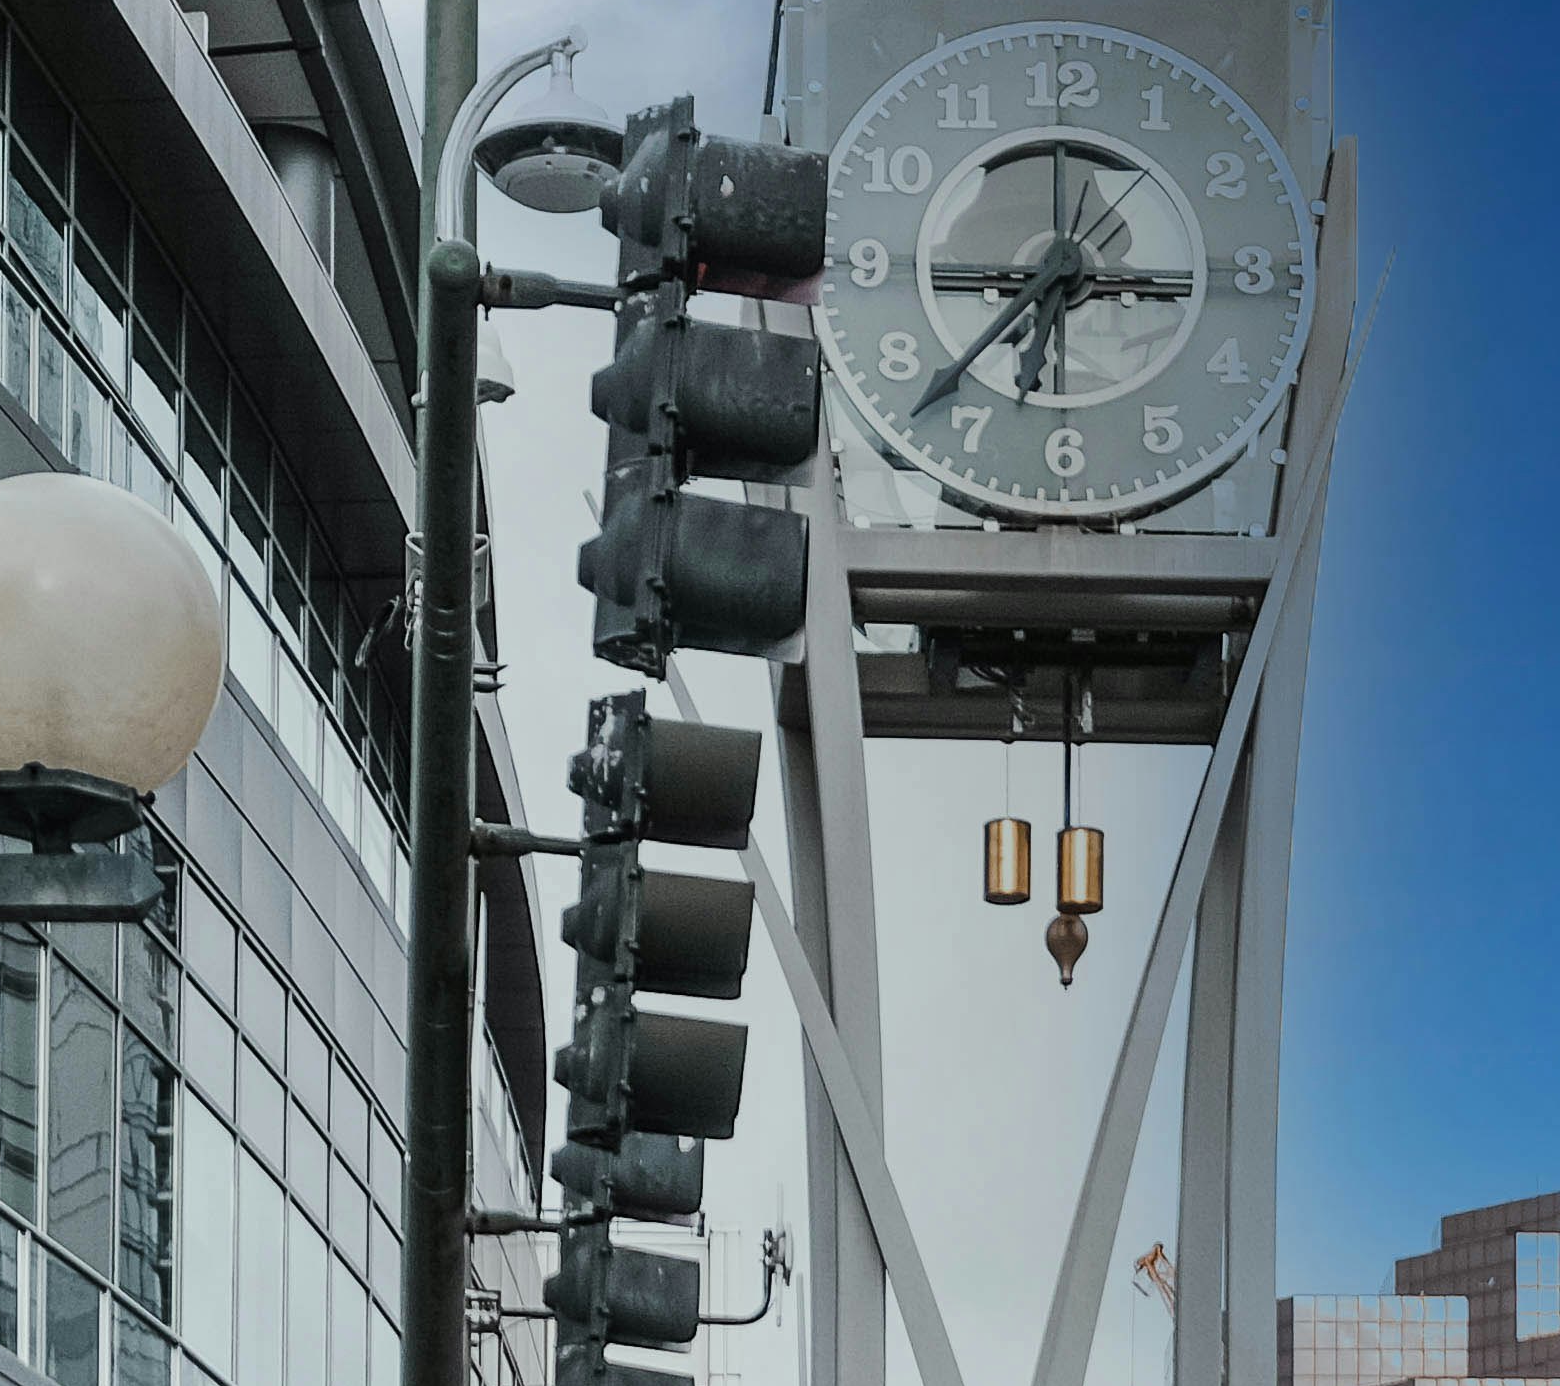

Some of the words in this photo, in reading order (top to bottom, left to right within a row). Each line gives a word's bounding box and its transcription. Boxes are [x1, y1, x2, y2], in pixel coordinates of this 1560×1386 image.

[936, 84, 997, 129] 11
[1025, 61, 1099, 108] 12
[1140, 85, 1171, 130] 1
[863, 146, 932, 194] 10
[1205, 152, 1247, 199] 2
[848, 238, 889, 288] 9
[1233, 247, 1274, 294] 3
[879, 332, 920, 381] 8
[1206, 338, 1250, 383] 4
[951, 405, 993, 453] 7
[1045, 428, 1085, 477] 6
[1143, 405, 1183, 455] 5
